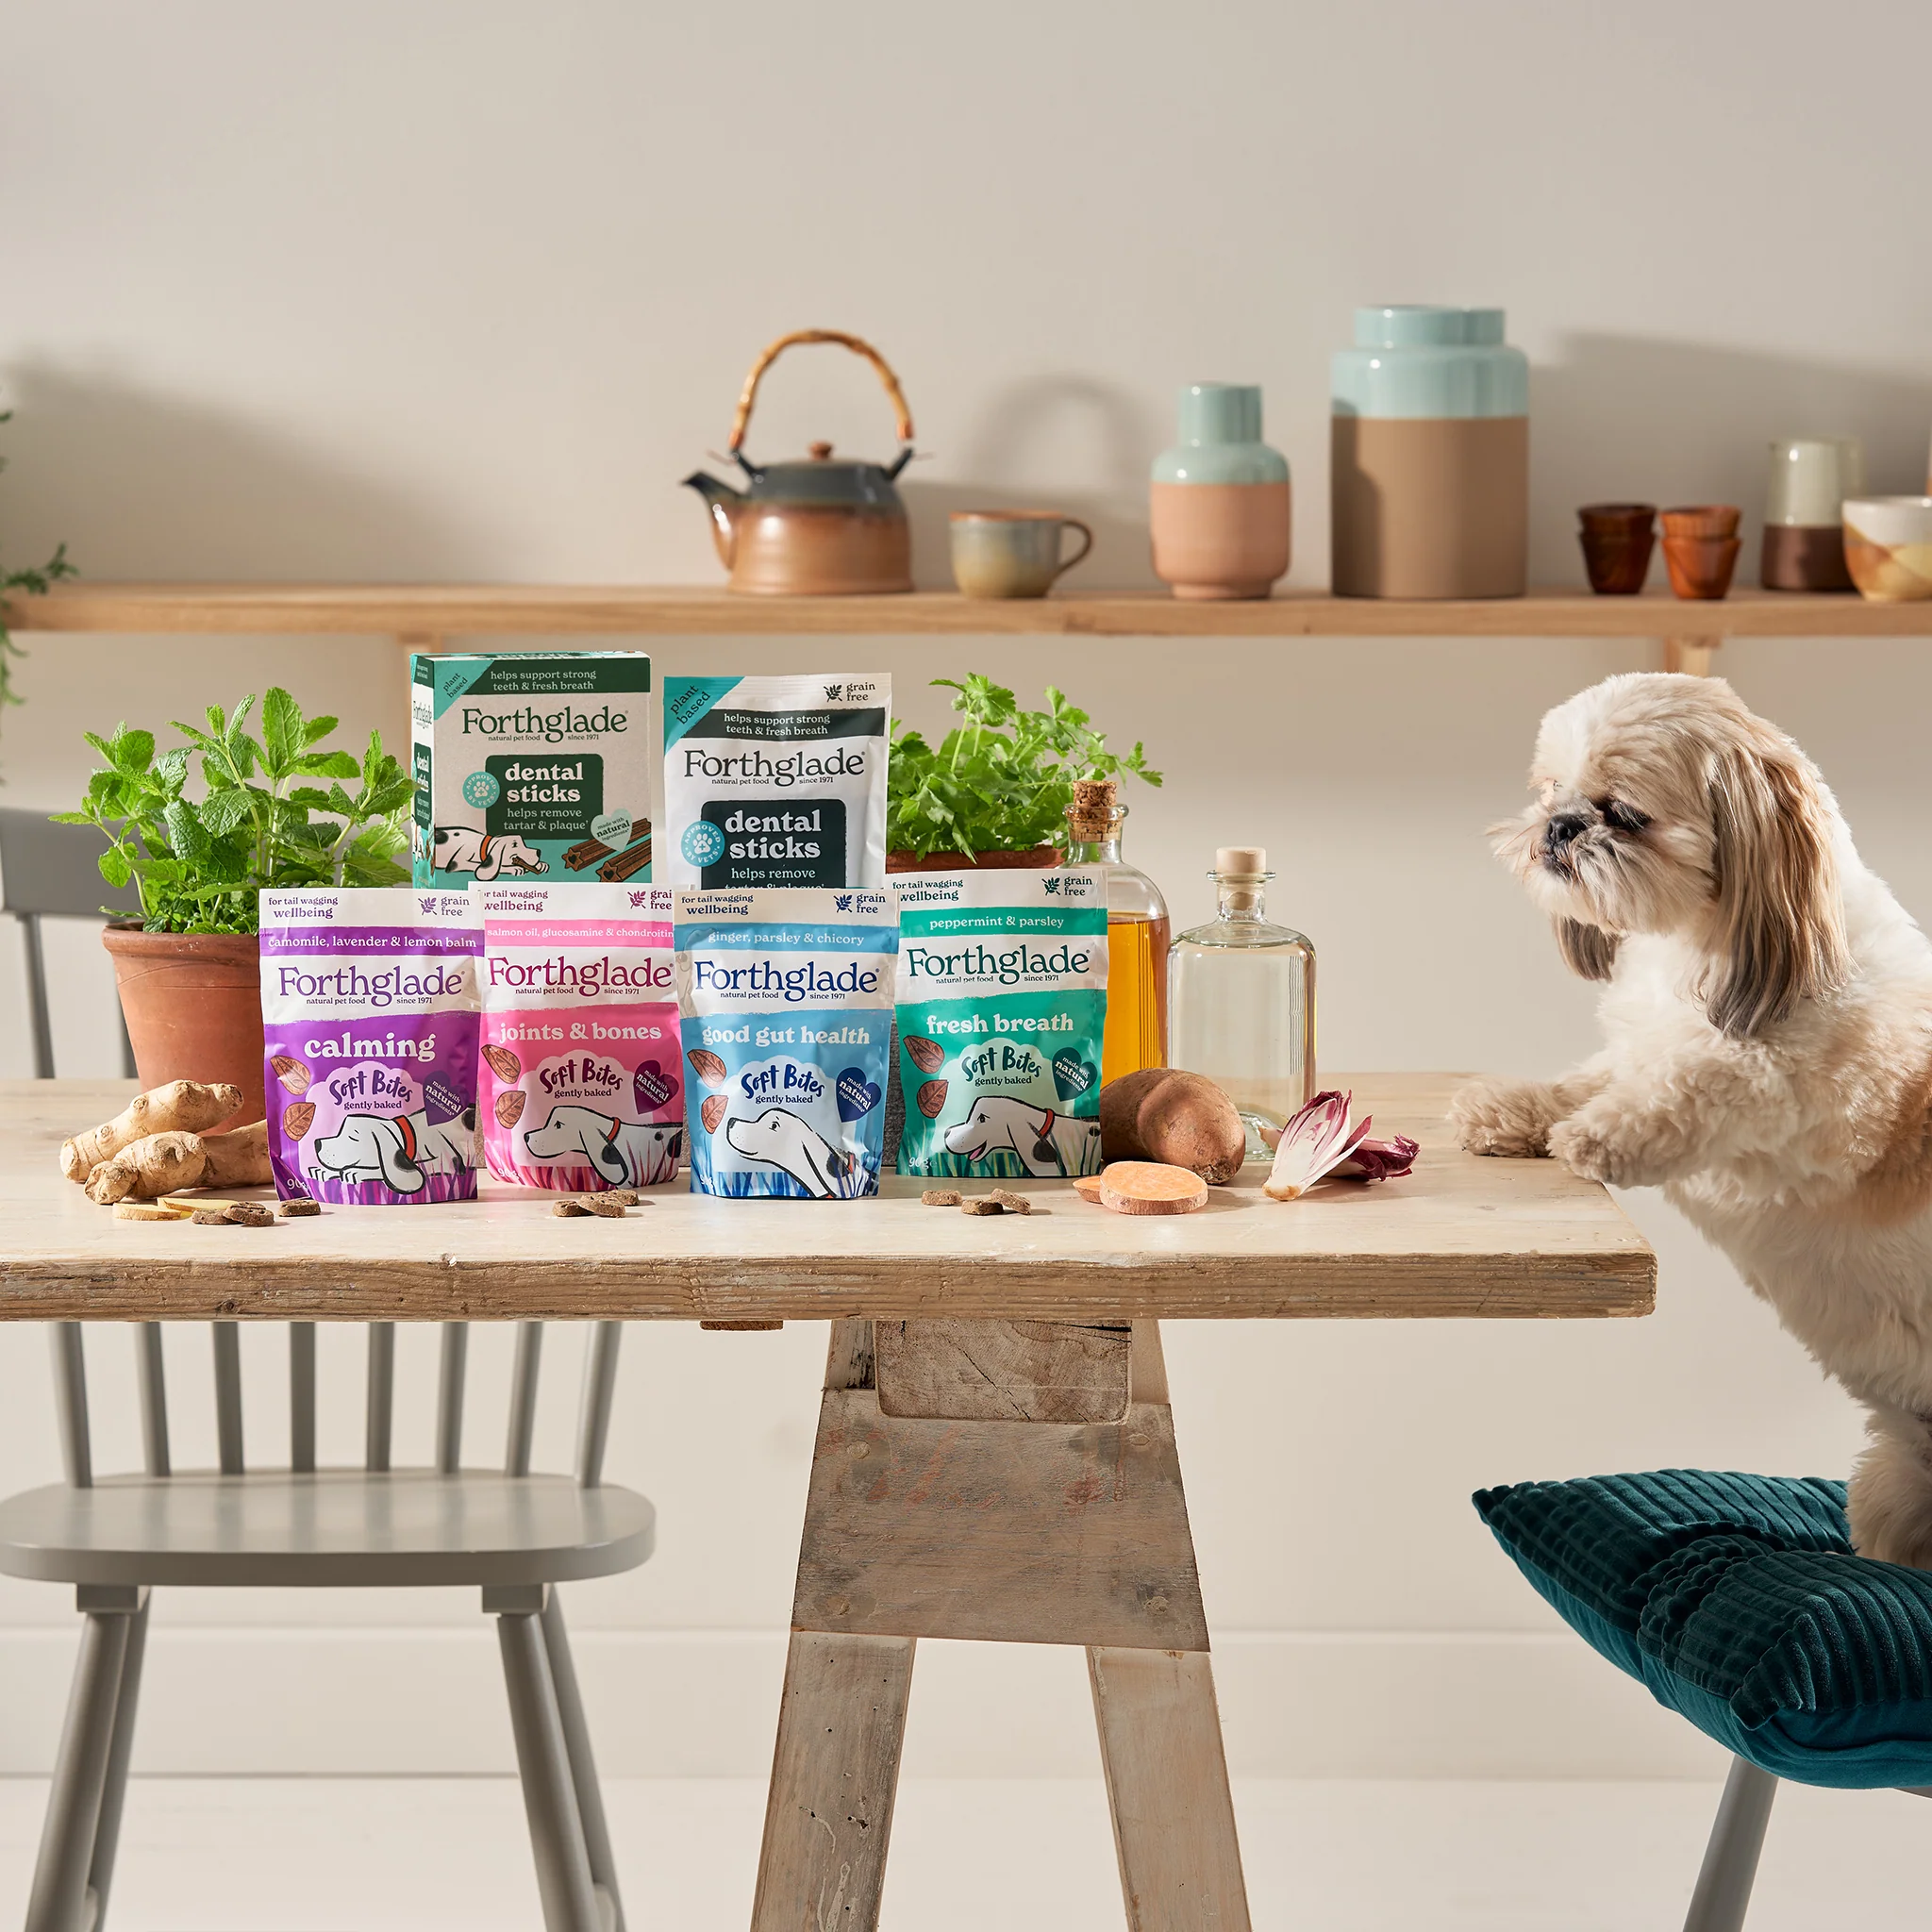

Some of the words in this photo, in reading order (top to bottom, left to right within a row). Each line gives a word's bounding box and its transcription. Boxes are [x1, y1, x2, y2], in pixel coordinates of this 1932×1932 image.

[443, 672, 461, 691] plant
[491, 671, 518, 680] helps
[520, 672, 560, 680] support
[563, 671, 597, 679] strong
[447, 677, 468, 698] based
[532, 682, 558, 691] fresh
[846, 683, 875, 691] grain
[670, 684, 699, 715] plant
[847, 692, 869, 701] free
[676, 692, 711, 724] based
[462, 707, 627, 742] Forthglade
[724, 714, 751, 724] helps
[754, 715, 794, 725] support
[797, 714, 830, 724] strong
[726, 726, 753, 735] teeth
[756, 726, 763, 735] &
[766, 726, 791, 736] fresh
[794, 726, 828, 735] breath
[505, 763, 584, 781] dental
[684, 747, 865, 787] Forthglade
[466, 774, 496, 790] APPROVED
[507, 784, 581, 803] sticks
[508, 808, 537, 819] helps
[724, 809, 822, 833] dental
[504, 821, 537, 830] tartar
[540, 821, 547, 829] &
[597, 820, 630, 837] natural
[685, 824, 721, 844] APPROVED
[687, 851, 696, 860] BY
[730, 836, 821, 859] sticks
[731, 868, 766, 881] helps
[769, 869, 816, 878] remove
[1064, 876, 1092, 886] grain
[908, 880, 924, 889] tail
[925, 879, 963, 889] wagging
[1064, 887, 1086, 896] free
[301, 897, 339, 906] wagging
[441, 897, 470, 907] grain
[510, 891, 549, 899] wagging
[650, 891, 673, 900] grai
[682, 895, 694, 904] for
[715, 894, 754, 903] wagging
[857, 894, 886, 904] grain
[441, 908, 463, 916] free
[650, 901, 673, 909] free
[687, 905, 749, 915] wellbeing
[857, 905, 878, 913] free
[274, 908, 334, 919] wellbeing
[929, 916, 1003, 930] peppermint
[1007, 917, 1016, 925] &
[1020, 917, 1064, 928] parsley
[487, 928, 523, 937] salmon
[525, 928, 541, 938] oil,
[542, 928, 604, 939] glucosamine
[607, 928, 614, 937] &
[616, 928, 674, 938] chondroitin
[708, 931, 751, 943] ginger,
[755, 932, 801, 944] parsley
[804, 934, 813, 942] &
[817, 933, 864, 945] chicory
[269, 936, 330, 948] camomile,
[333, 936, 389, 947] lavender
[391, 937, 401, 947] &
[404, 936, 442, 947] lemon
[445, 937, 476, 948] balm
[907, 944, 1090, 985] Forthglade
[488, 957, 673, 997] Forthglade
[694, 960, 877, 1002] Forthglade
[278, 965, 462, 1007] Forthglade
[926, 1014, 989, 1034] fresh
[993, 1013, 1074, 1032] breath
[499, 1024, 564, 1044] joints
[570, 1023, 589, 1040] &
[592, 1024, 662, 1040] bones
[702, 1025, 750, 1046] good
[755, 1026, 795, 1046] gut
[801, 1026, 870, 1044] health
[304, 1032, 436, 1063] calming
[961, 1048, 998, 1082] Soft
[1002, 1046, 1041, 1077] Bites
[1062, 1058, 1079, 1070] made
[1079, 1068, 1090, 1079] with
[540, 1059, 577, 1094] Soft
[582, 1058, 624, 1091] Bites
[644, 1070, 657, 1082] made
[657, 1080, 668, 1091] with
[741, 1064, 779, 1100] Soft
[784, 1064, 824, 1098] Bites
[975, 1077, 1004, 1087] gently
[1005, 1076, 1032, 1085] baked
[1056, 1061, 1089, 1090] natural
[329, 1071, 367, 1107] Soft
[372, 1070, 413, 1103] Bites
[433, 1081, 448, 1094] made
[448, 1092, 460, 1103] with
[555, 1090, 582, 1099] gently
[584, 1089, 612, 1097] baked
[637, 1074, 669, 1101] natural
[840, 1081, 872, 1110] natural
[847, 1077, 863, 1091] made
[863, 1089, 872, 1100] with
[344, 1102, 373, 1110] gently
[374, 1101, 402, 1109] baked
[425, 1086, 461, 1113] natural
[756, 1095, 784, 1104] gently
[785, 1094, 813, 1104] baked
